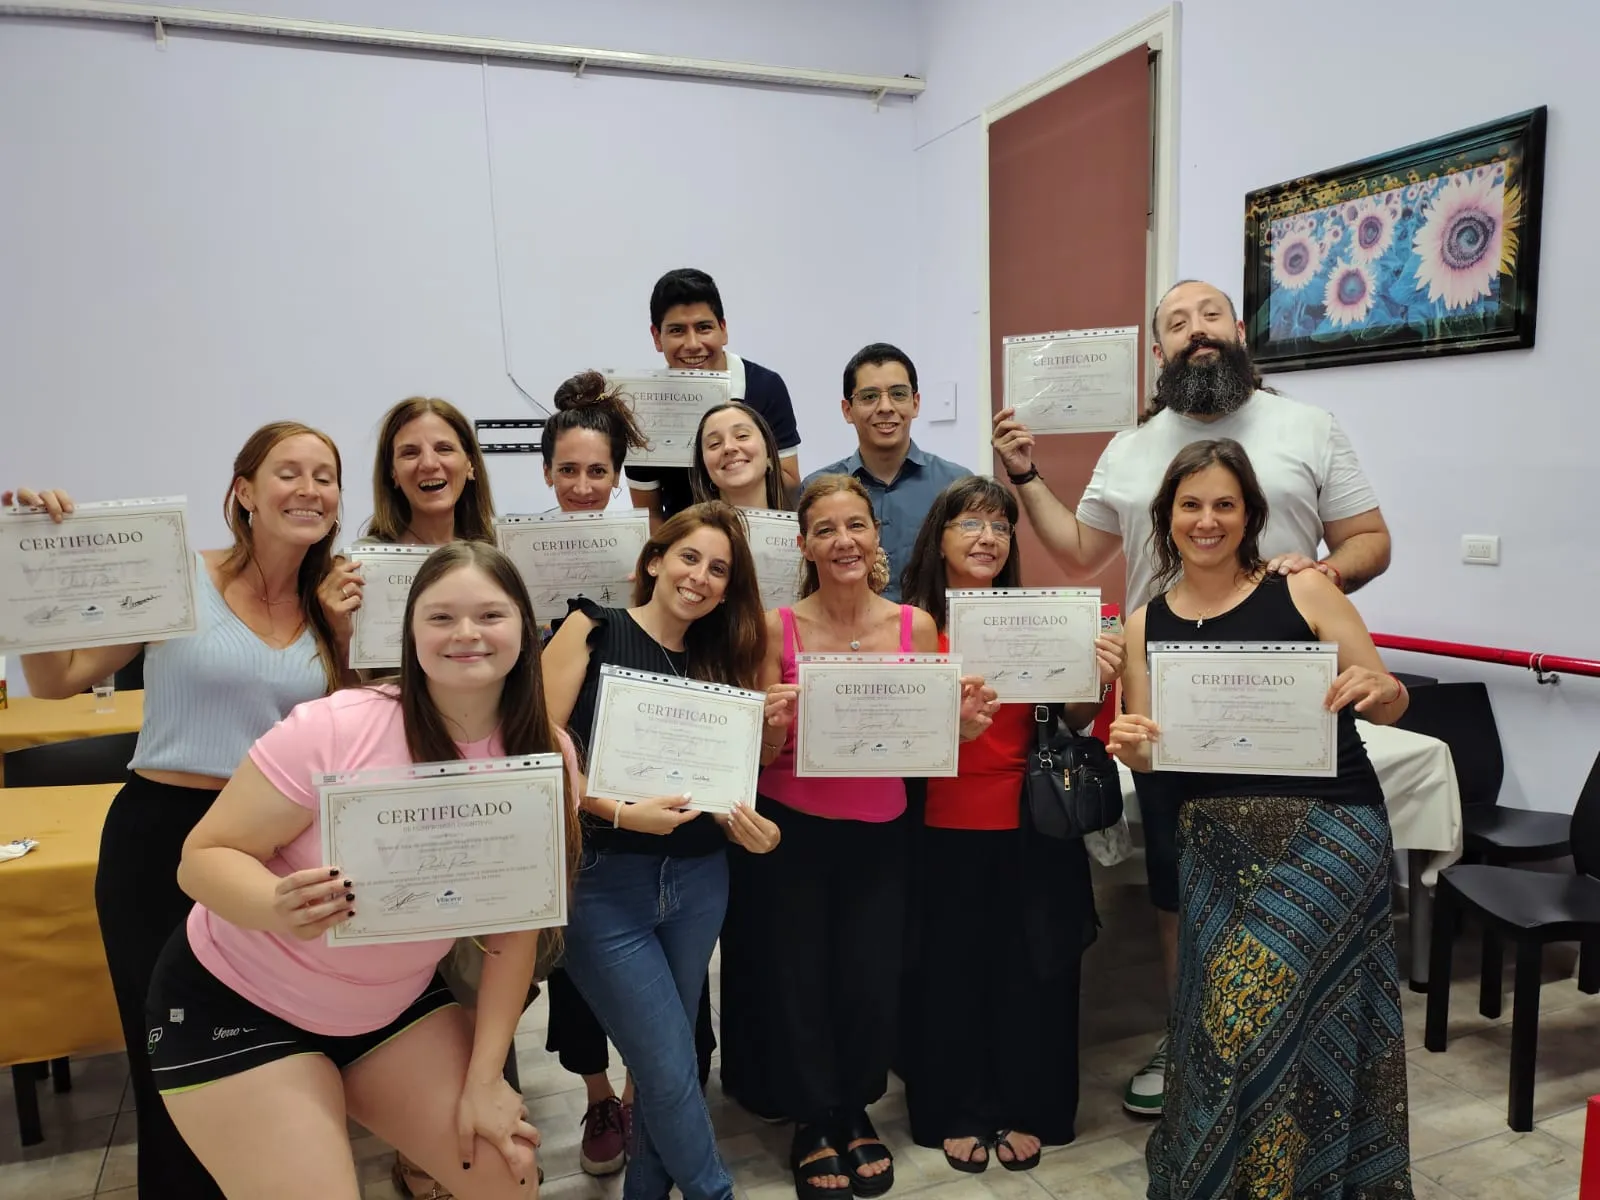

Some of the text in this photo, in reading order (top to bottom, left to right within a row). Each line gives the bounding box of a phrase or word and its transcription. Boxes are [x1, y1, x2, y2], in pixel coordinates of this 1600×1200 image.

[633, 392, 703, 402] CERTIFICADO
[19, 531, 143, 552] CERTIFICADO
[532, 538, 618, 551] CERTIFICADO
[983, 615, 1068, 626] CERTIFICADO
[1191, 674, 1295, 686] CERTIFICADO
[835, 684, 926, 695] CERTIFICADO
[637, 702, 728, 726] CERTIFICADO
[376, 800, 513, 825] CERTIFICADO
